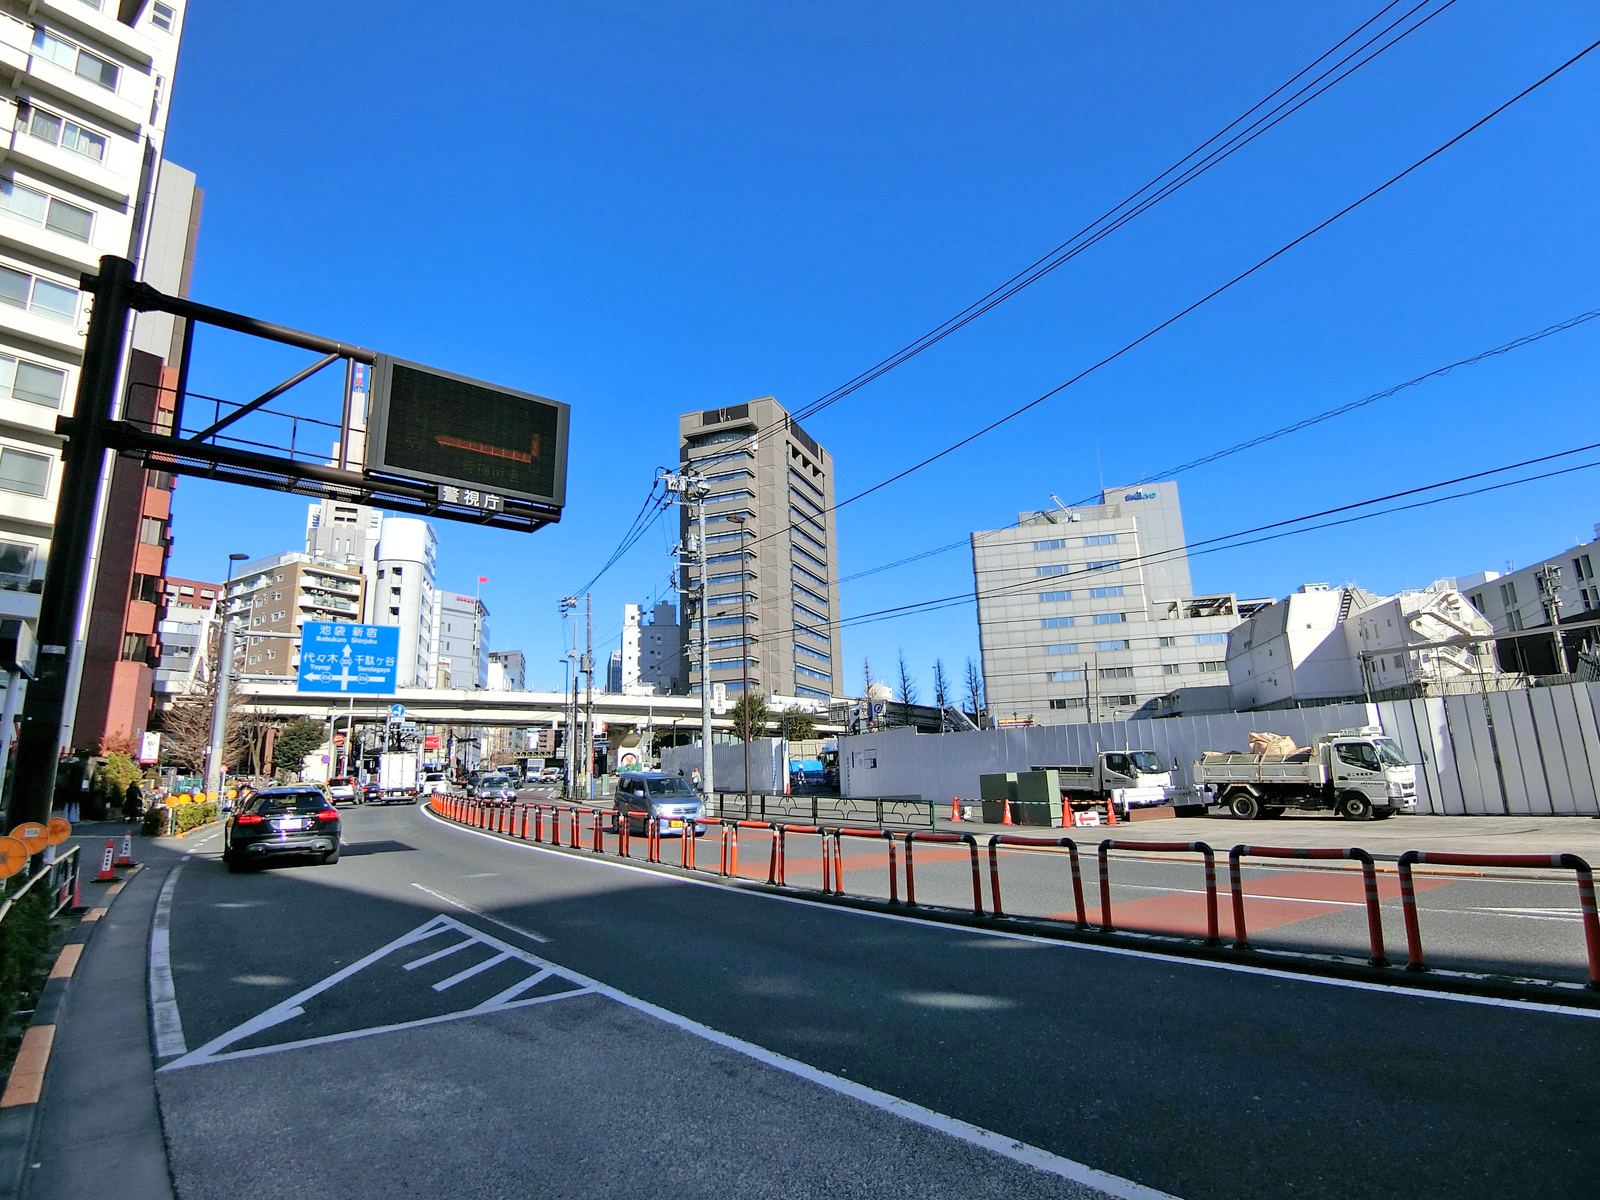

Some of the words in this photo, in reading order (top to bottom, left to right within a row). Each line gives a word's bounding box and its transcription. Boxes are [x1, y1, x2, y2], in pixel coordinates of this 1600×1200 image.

[443, 486, 500, 510] 警視庁
[320, 625, 346, 636] 池袋
[352, 627, 378, 638] 新宿
[351, 637, 377, 645] Shinjuku
[303, 652, 339, 664] 代々木
